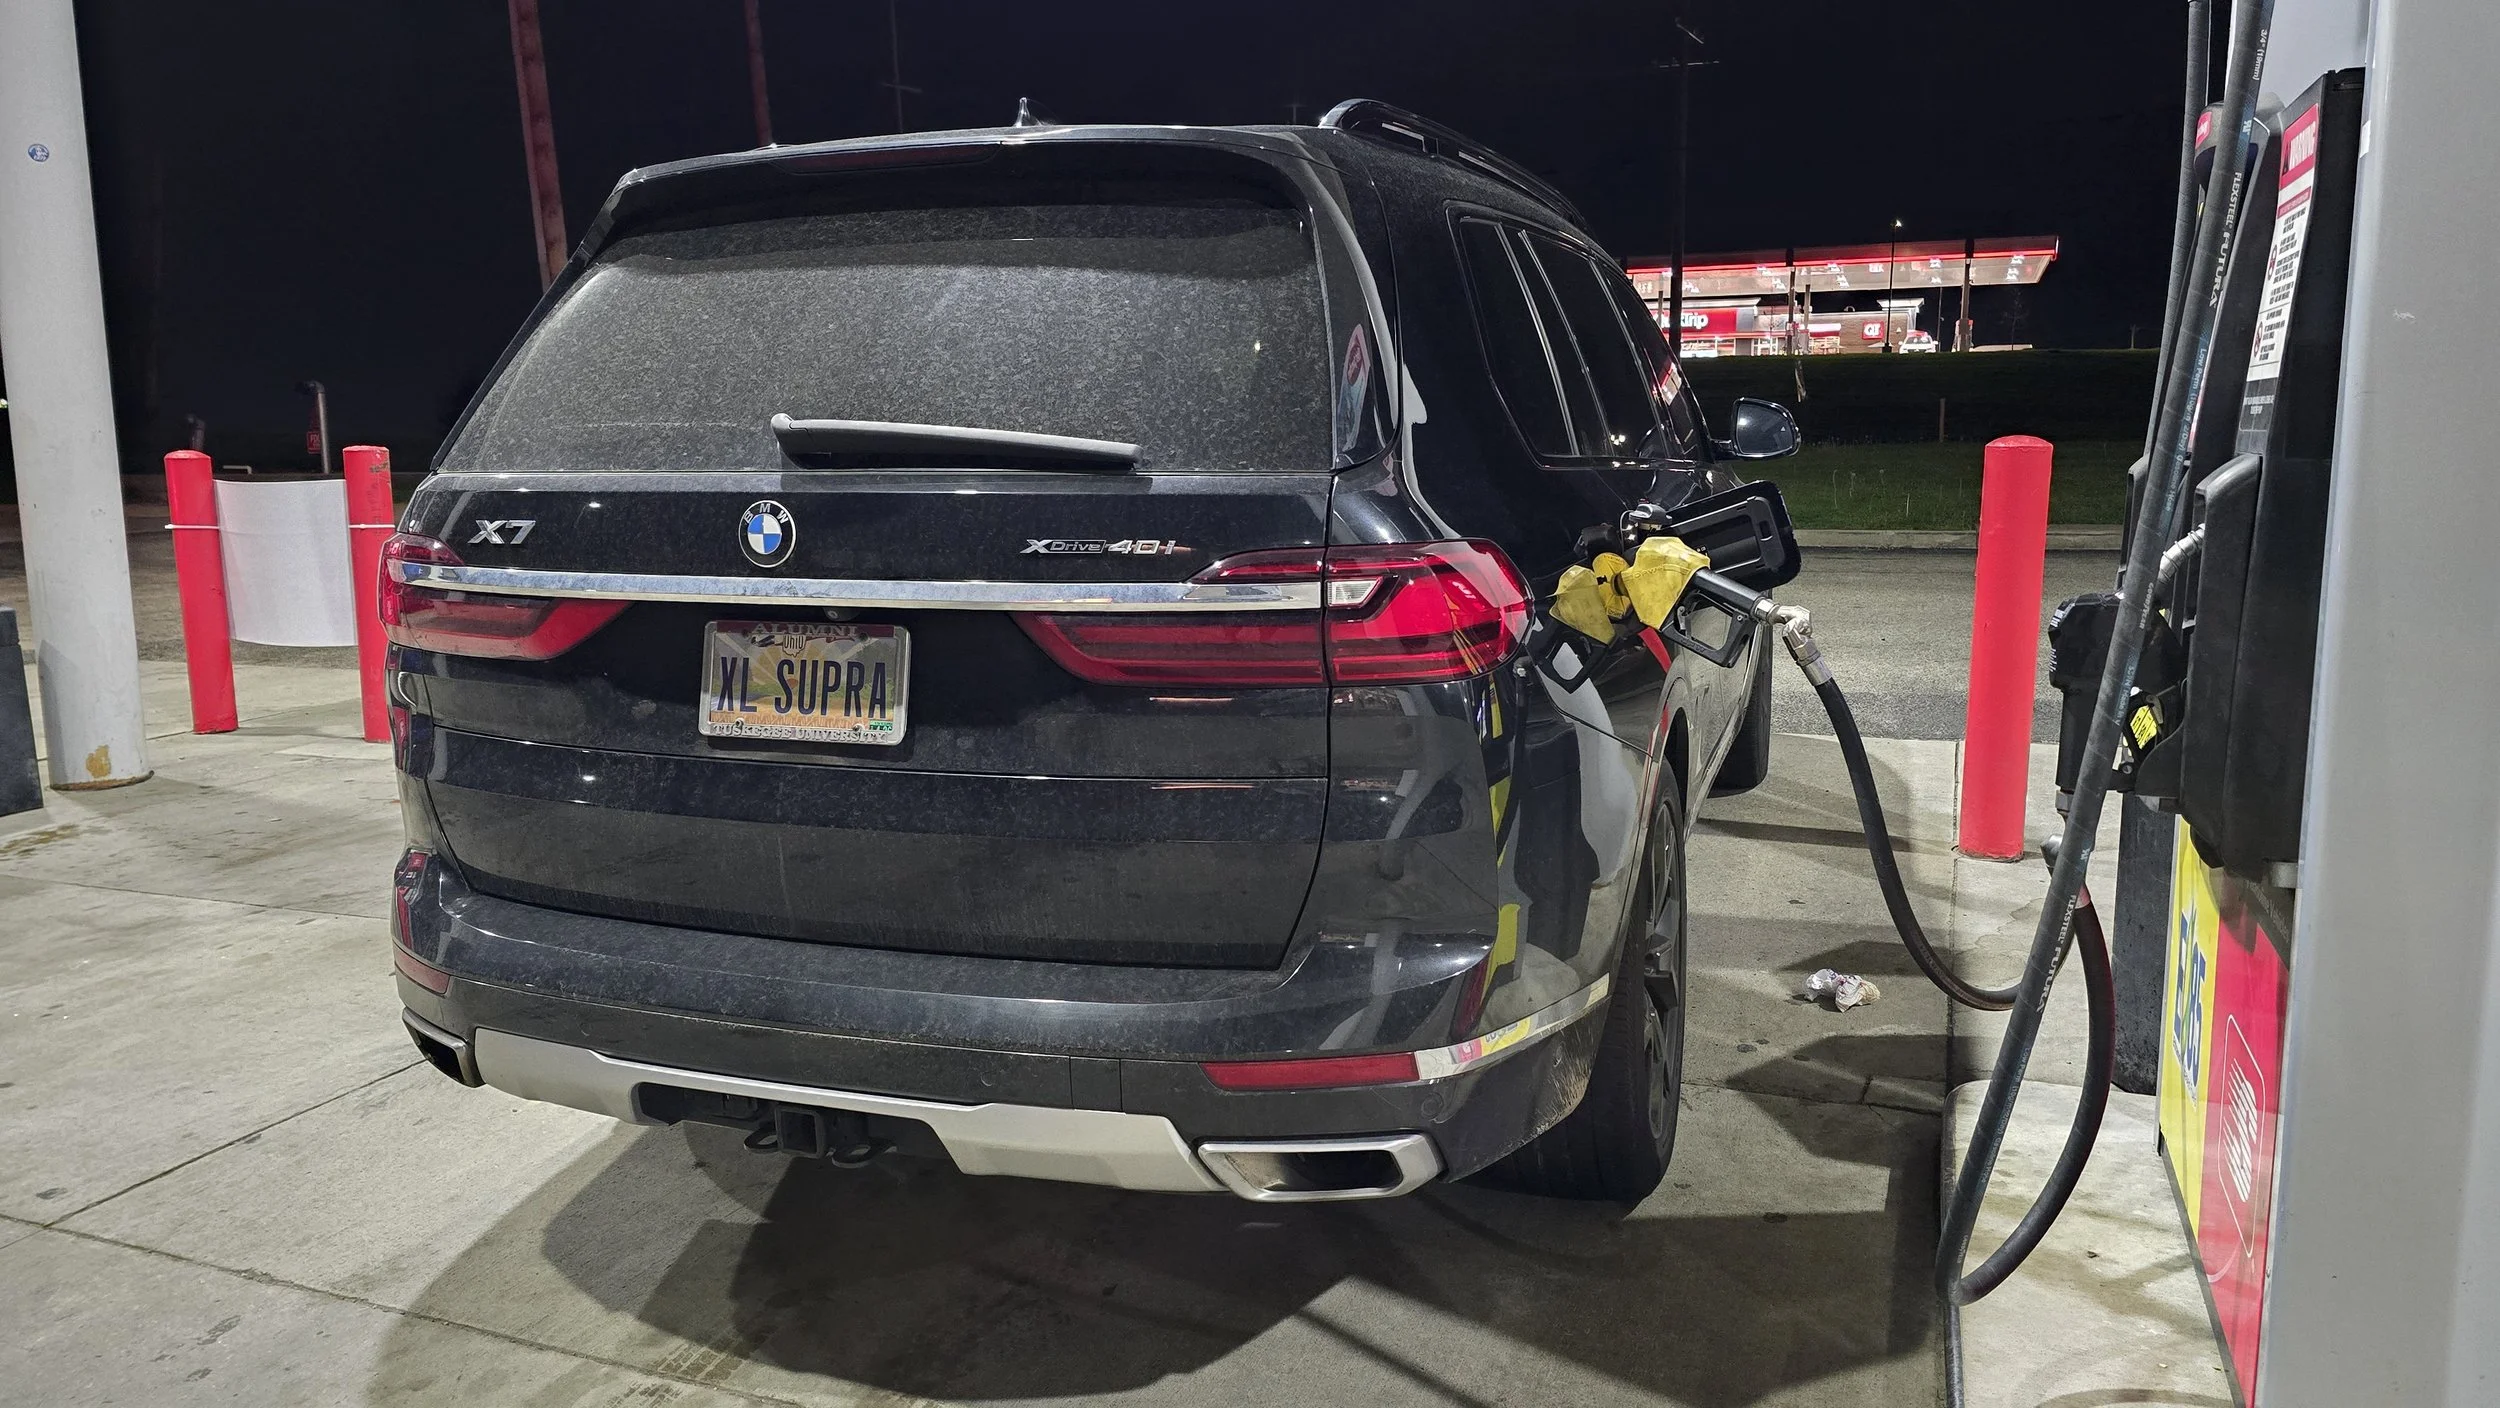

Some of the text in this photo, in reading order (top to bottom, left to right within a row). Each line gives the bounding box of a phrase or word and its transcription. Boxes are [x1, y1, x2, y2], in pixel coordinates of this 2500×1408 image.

[2252, 48, 2264, 80] (19mm)
[2196, 347, 2206, 366] Low
[2191, 366, 2202, 389] Perm
[743, 503, 789, 524] BMW
[467, 519, 537, 545] X7
[2138, 582, 2154, 630] GOODYEAR
[751, 622, 858, 637] ALUMNI
[717, 656, 886, 719] XL SUPRA
[713, 724, 890, 744] TUSKEGEE UNIVERSITY
